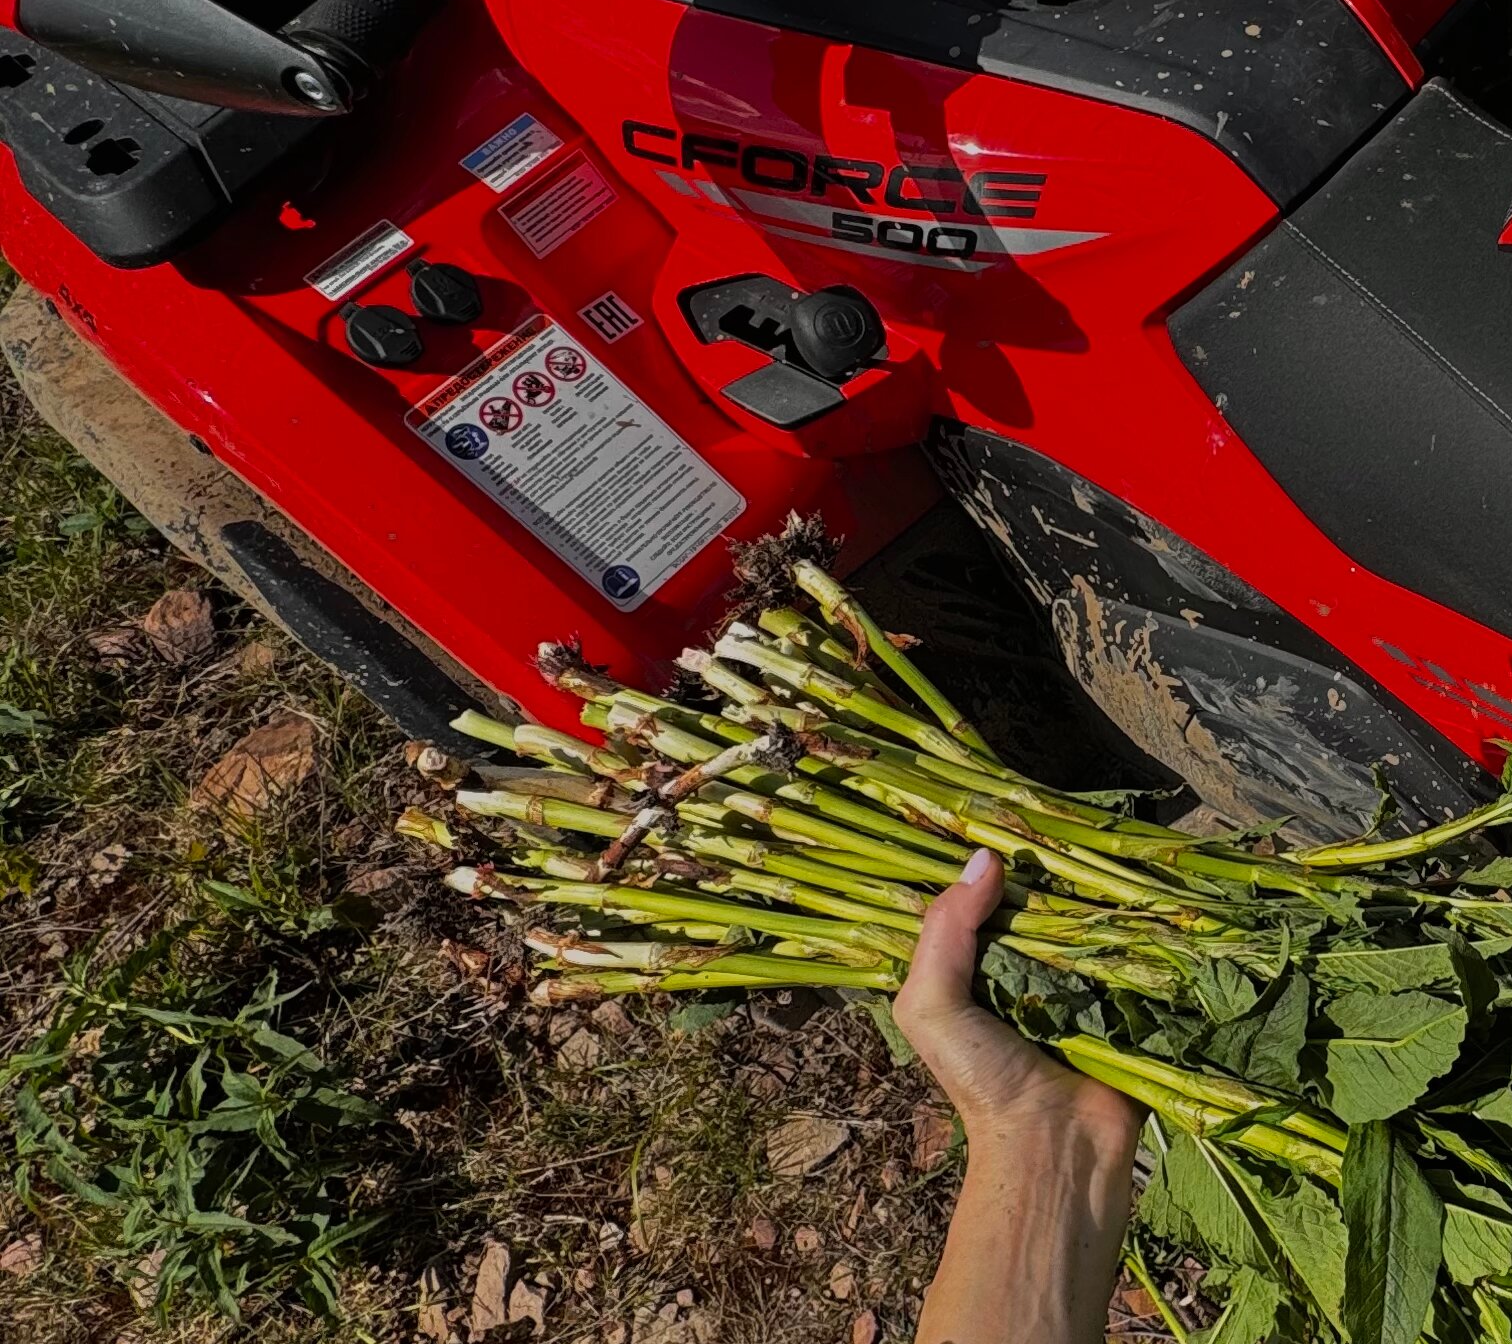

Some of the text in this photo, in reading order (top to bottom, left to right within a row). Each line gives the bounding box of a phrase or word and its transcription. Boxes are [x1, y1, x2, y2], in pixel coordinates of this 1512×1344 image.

[481, 127, 518, 156] ВАЖНО
[622, 119, 1048, 218] CFORCE
[831, 211, 978, 259] 500
[432, 326, 537, 409] ПРЕДОСТЕРЕЖЕНИЕ
